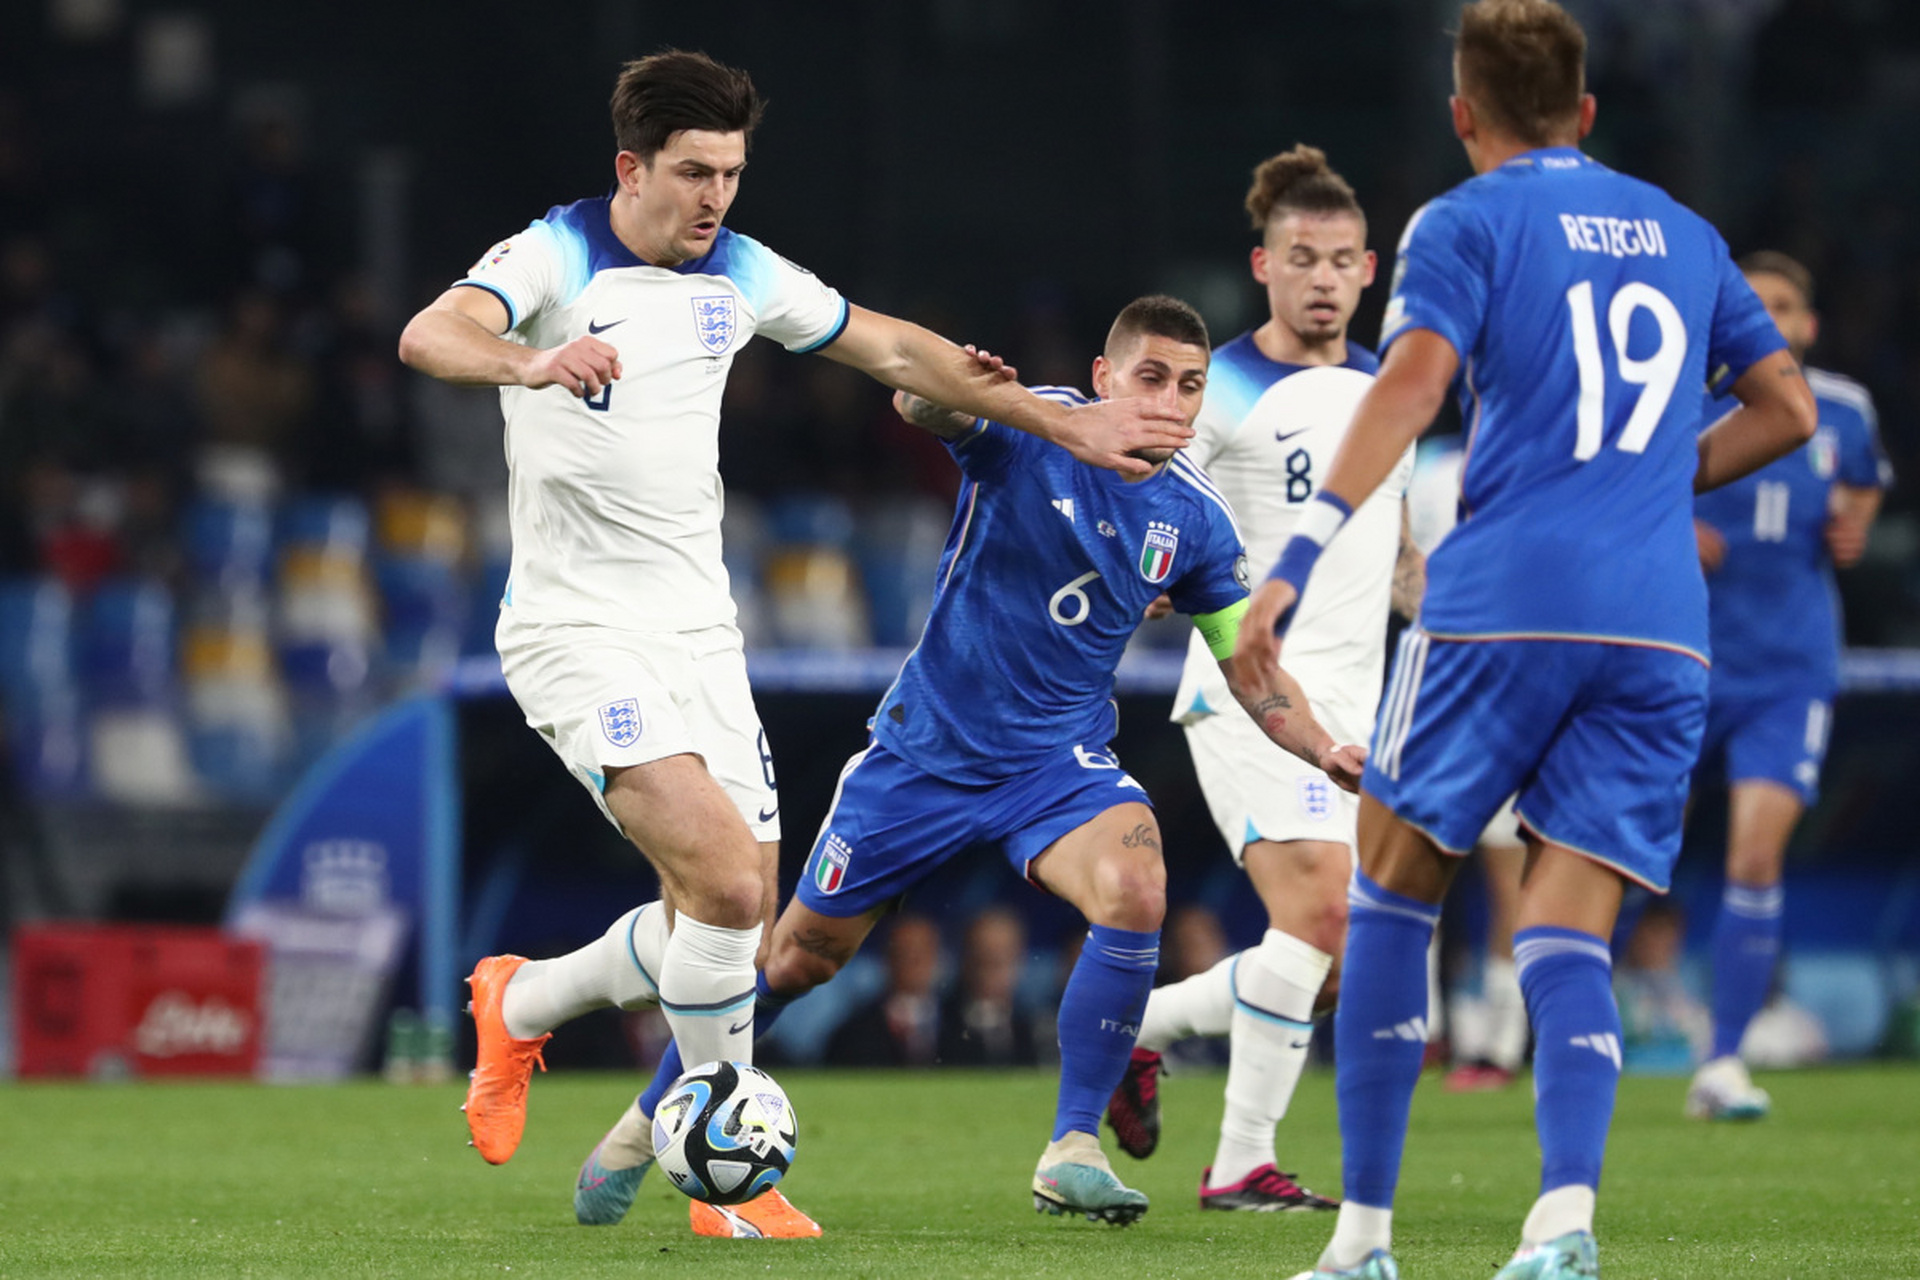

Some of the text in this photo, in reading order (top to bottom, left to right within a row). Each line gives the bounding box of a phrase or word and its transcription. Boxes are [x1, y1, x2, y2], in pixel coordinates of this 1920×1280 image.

[1559, 213, 1667, 257] RETEGUI
[1567, 280, 1688, 461] 19
[1286, 447, 1312, 503] 8
[1754, 481, 1790, 542] 11
[1147, 533, 1174, 548] ITALIA
[1048, 570, 1101, 626] 6
[1072, 744, 1119, 770] 6
